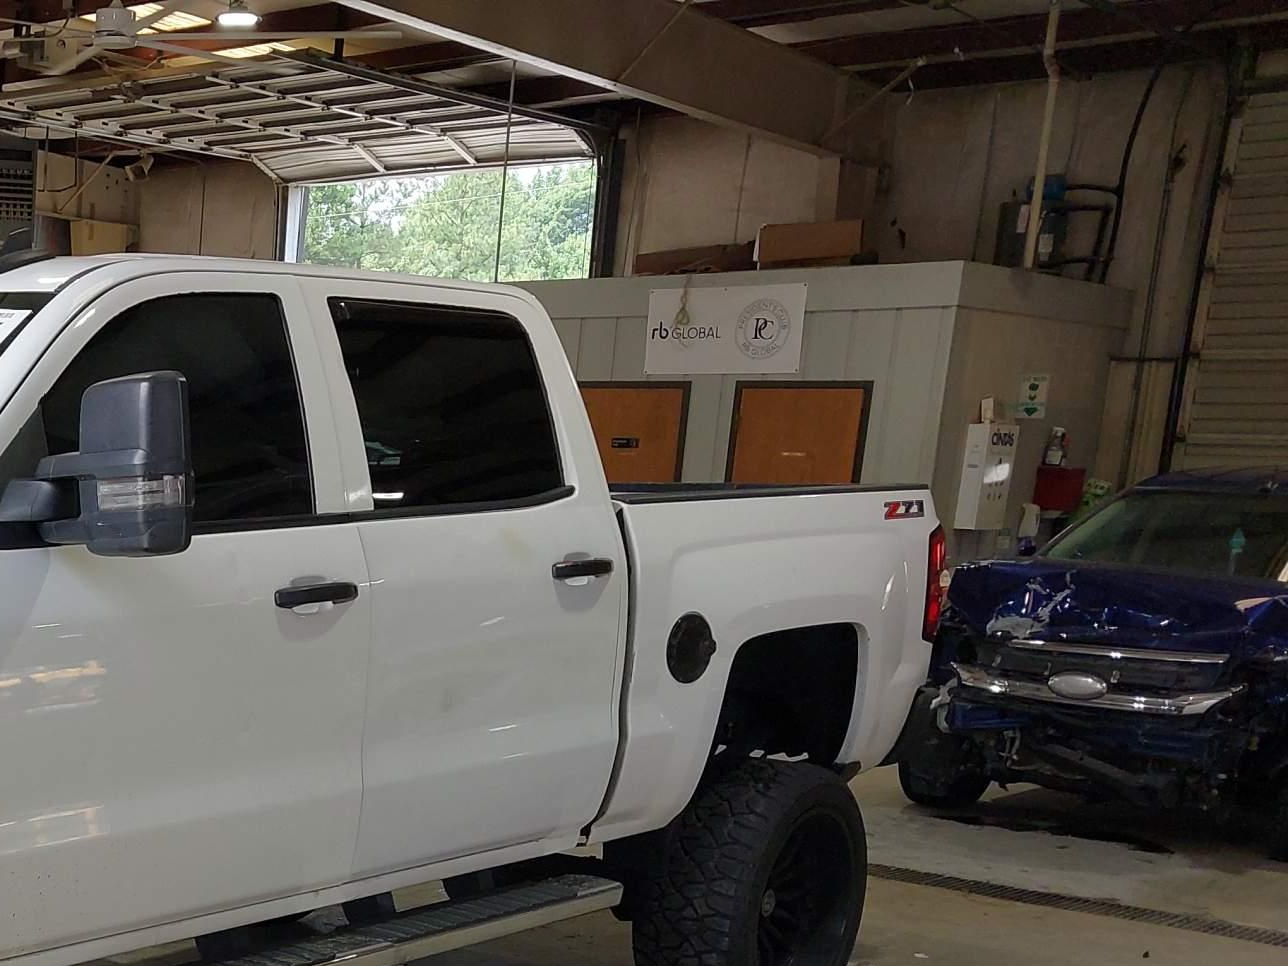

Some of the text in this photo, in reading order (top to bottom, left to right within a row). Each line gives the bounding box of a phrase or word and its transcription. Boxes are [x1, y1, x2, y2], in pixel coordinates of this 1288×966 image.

[651, 321, 721, 340] rb GLOBAL
[883, 499, 925, 520] Z71
